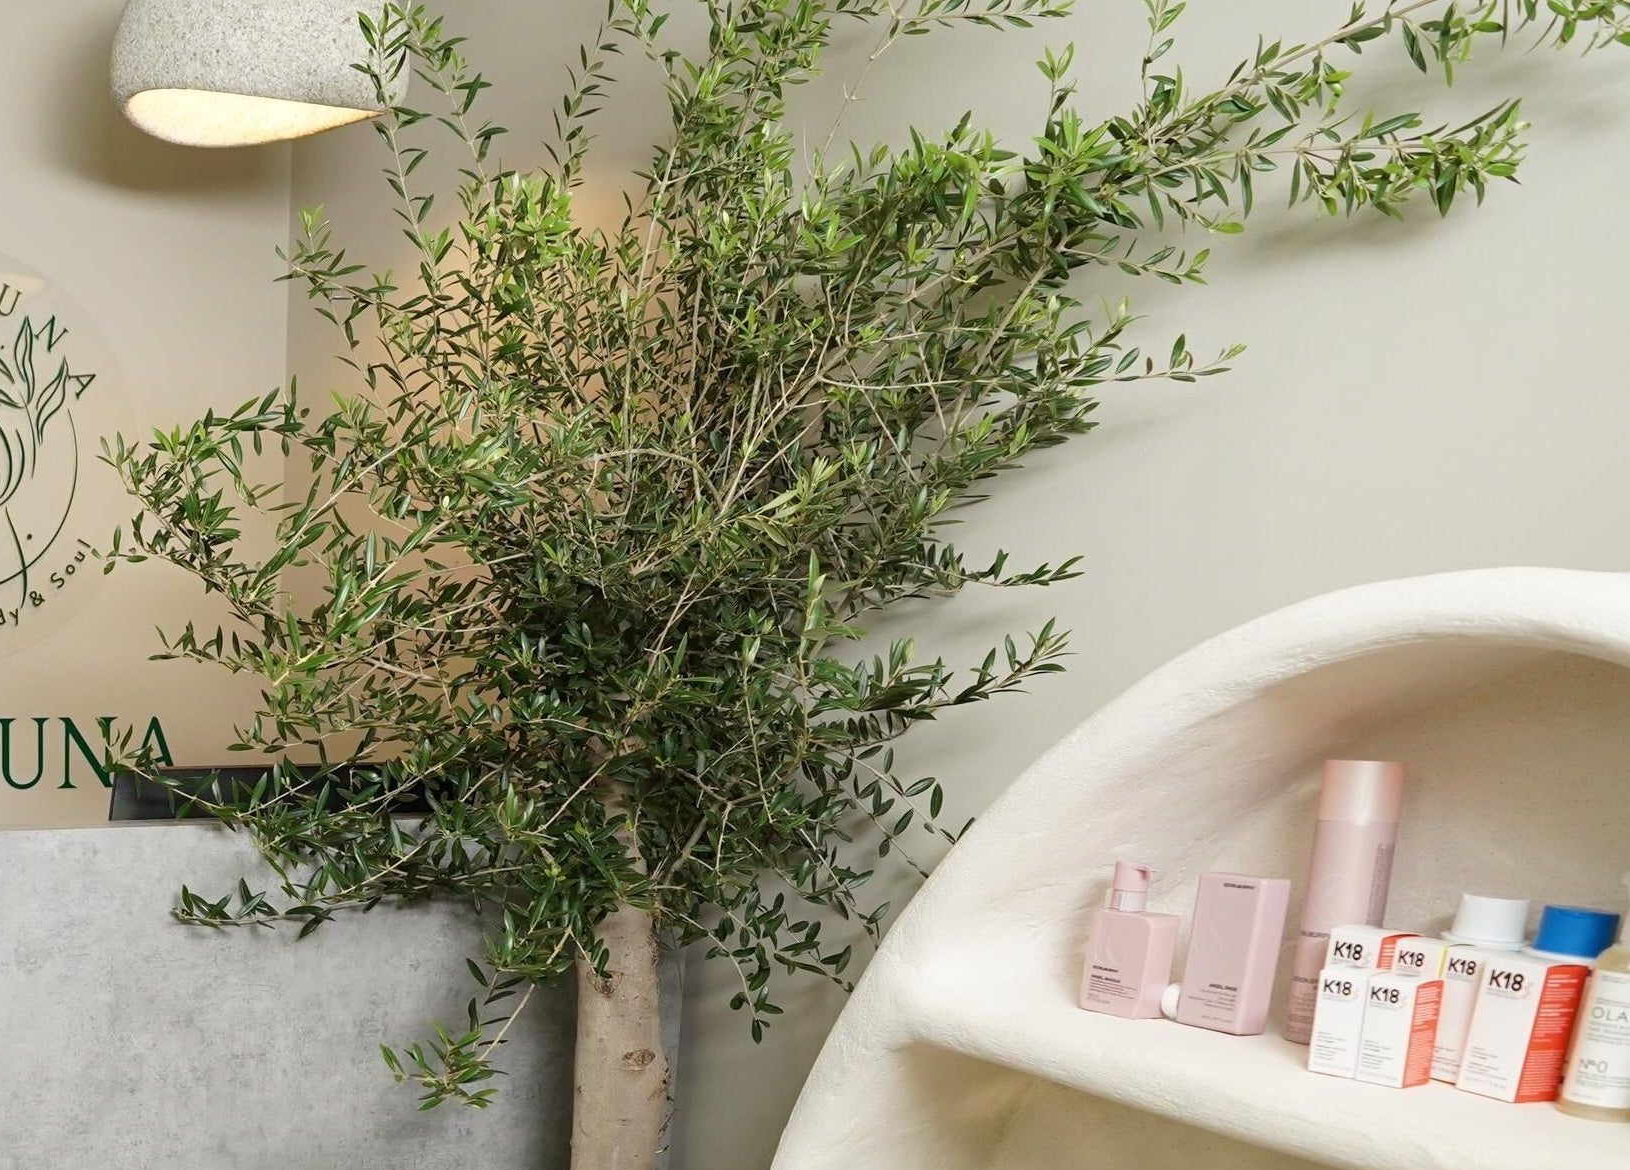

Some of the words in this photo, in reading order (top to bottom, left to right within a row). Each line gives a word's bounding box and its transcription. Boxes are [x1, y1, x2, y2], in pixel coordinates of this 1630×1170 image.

[29, 590, 46, 607] &
[50, 538, 91, 589] Soul
[1333, 940, 1363, 961] K18
[1397, 950, 1425, 967] K18
[1448, 957, 1477, 976] K18
[1323, 979, 1352, 996] K18
[1489, 968, 1524, 992] K18
[1370, 985, 1400, 1004] K18
